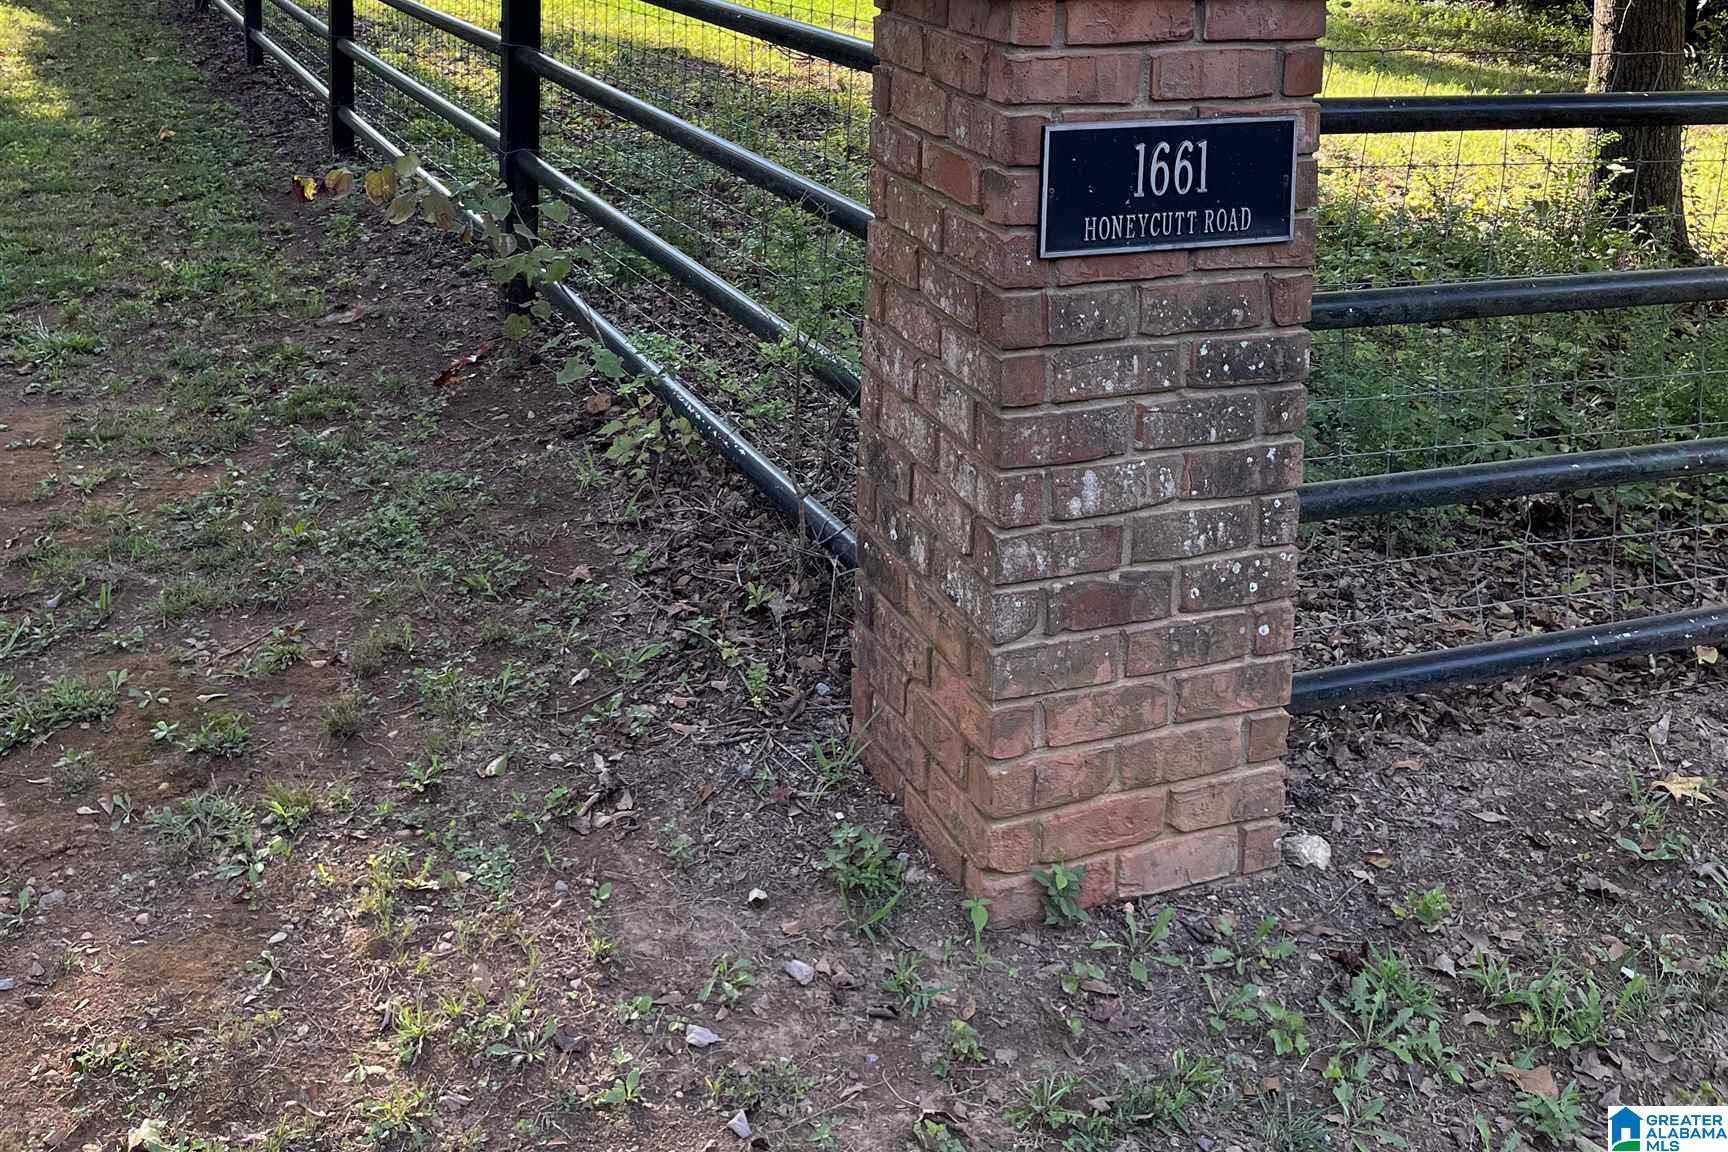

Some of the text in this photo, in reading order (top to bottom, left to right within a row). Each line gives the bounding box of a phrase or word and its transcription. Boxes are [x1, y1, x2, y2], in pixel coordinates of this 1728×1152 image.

[1133, 139, 1208, 198] 1661
[1083, 207, 1253, 242] HONEYCUTT ROAD
